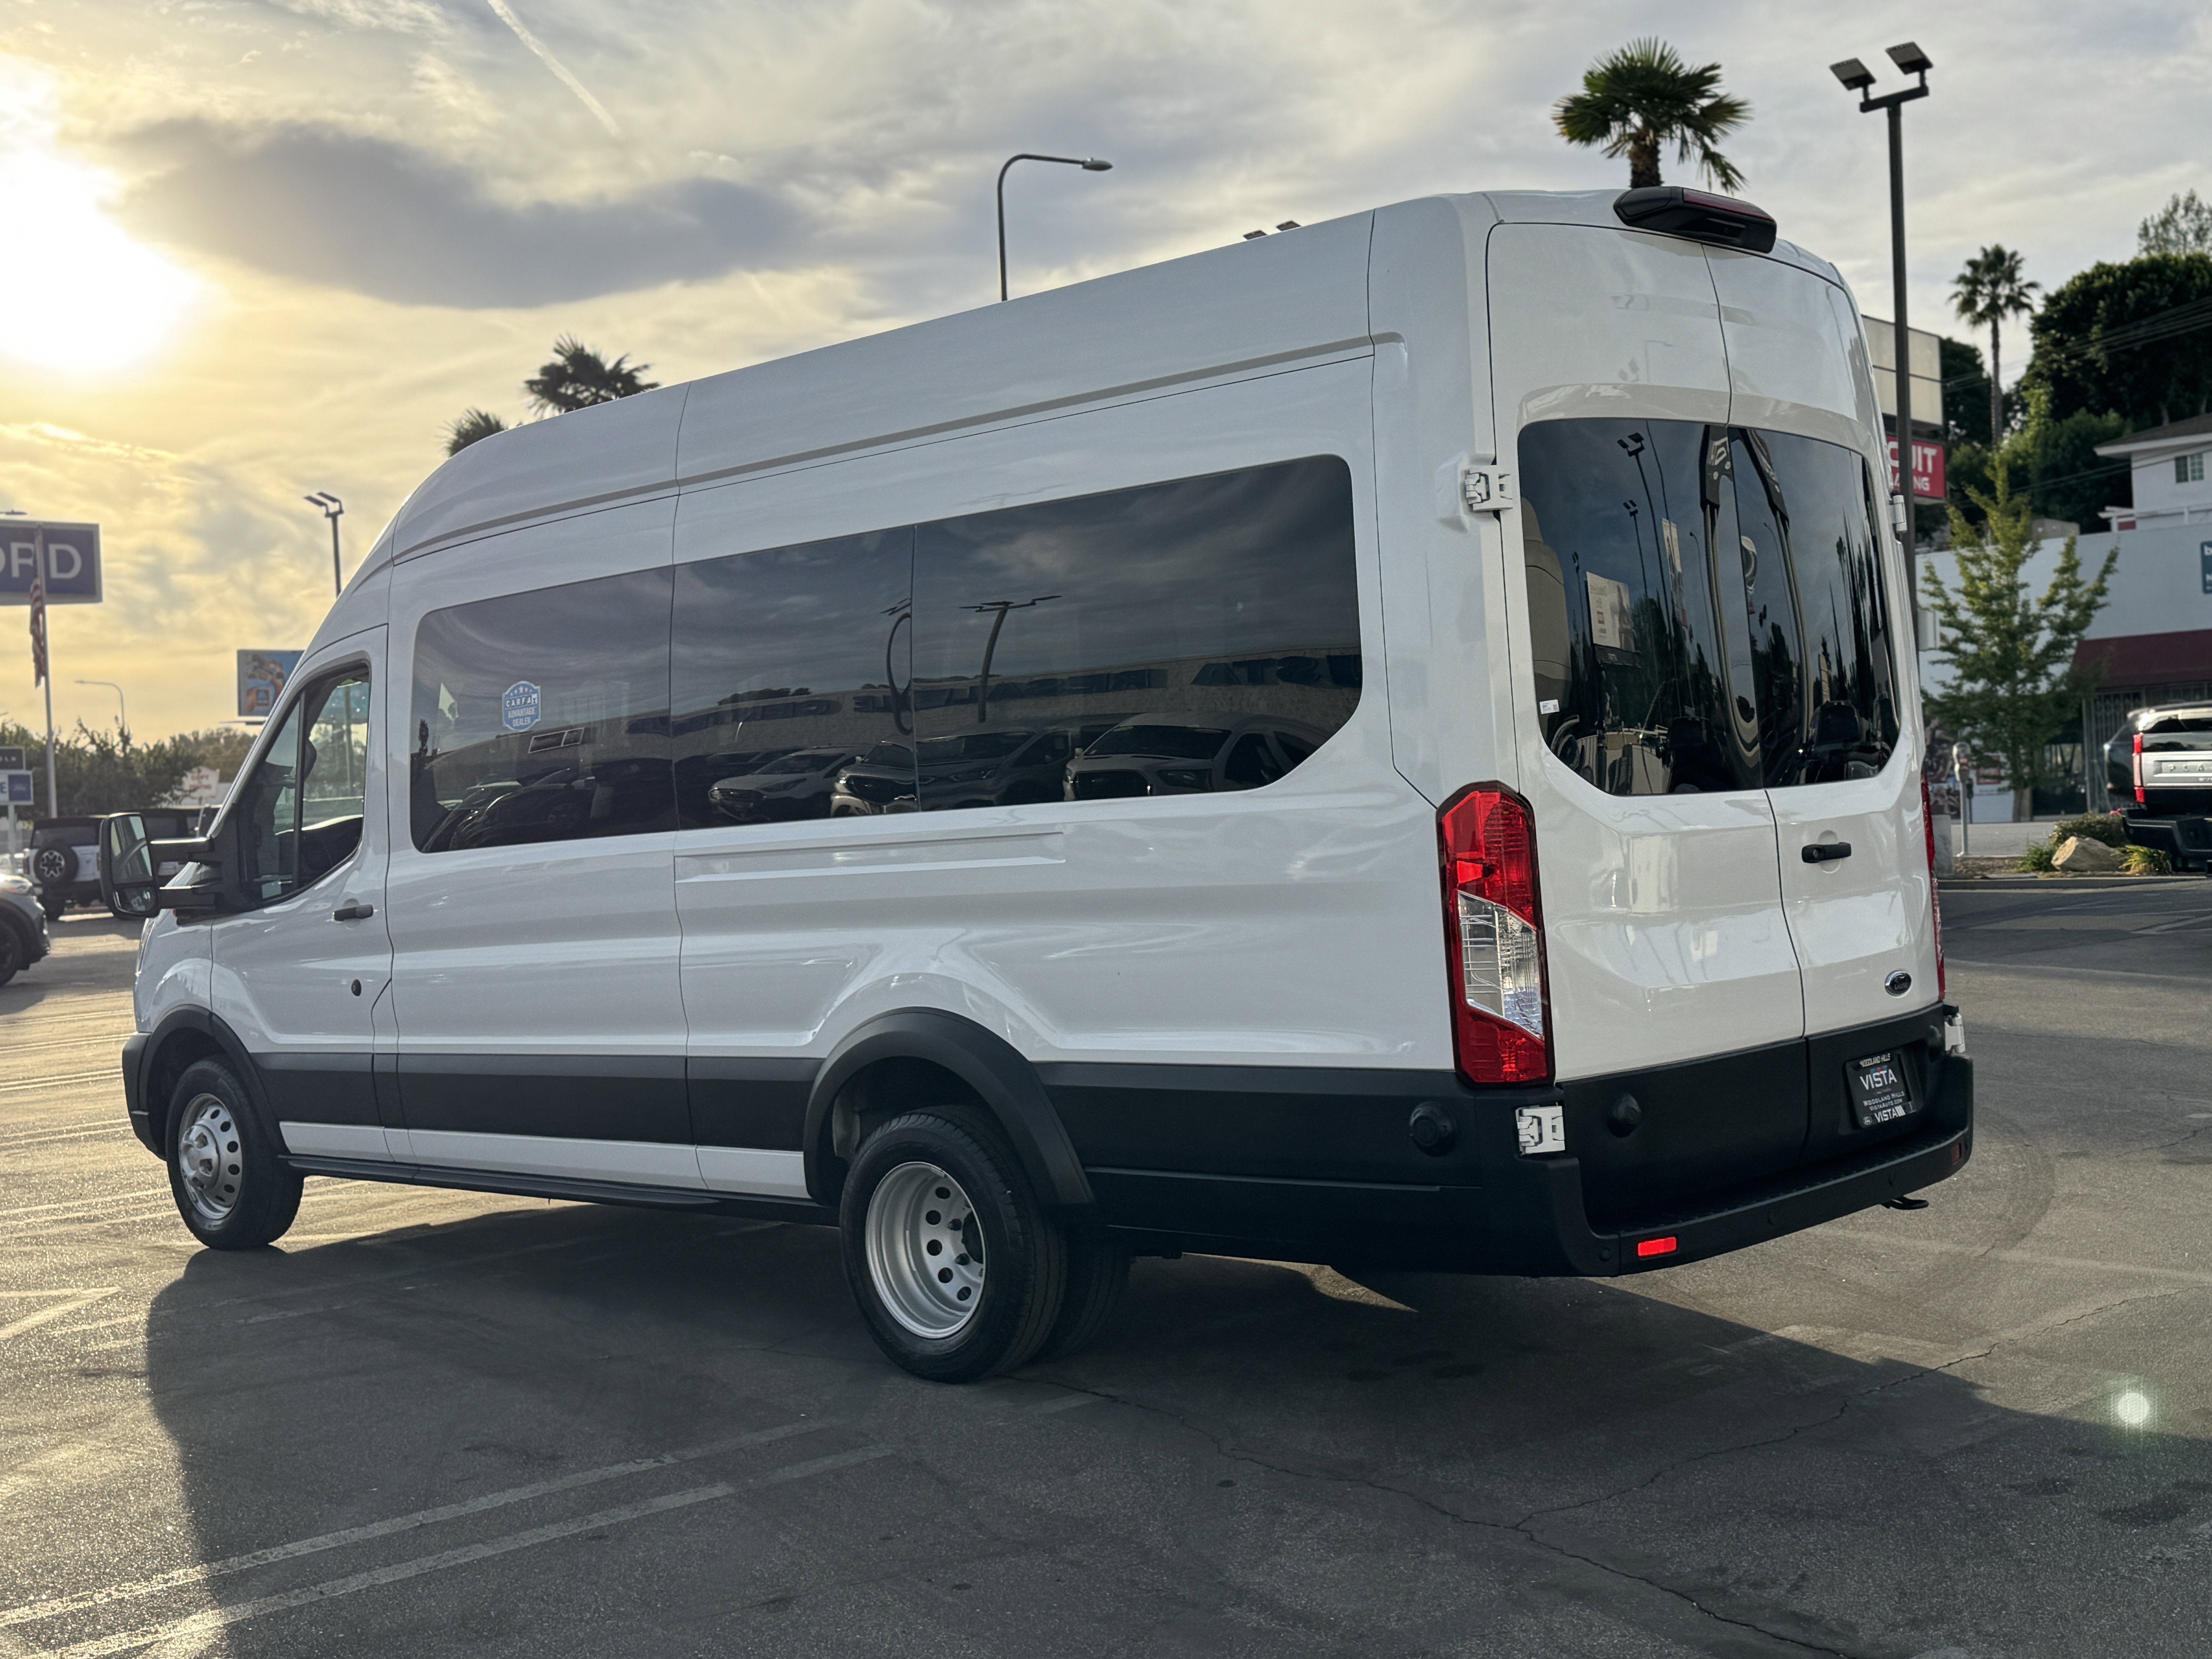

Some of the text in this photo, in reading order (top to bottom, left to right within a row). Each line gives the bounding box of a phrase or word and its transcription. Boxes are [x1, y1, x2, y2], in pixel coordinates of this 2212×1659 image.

[0, 542, 81, 579] RD
[506, 694, 538, 708] CARFAX
[508, 706, 535, 719] ADVANTAGE
[513, 716, 531, 727] DEALER
[1860, 1069, 1897, 1090] VISTA
[1874, 1108, 1898, 1123] VISTA
